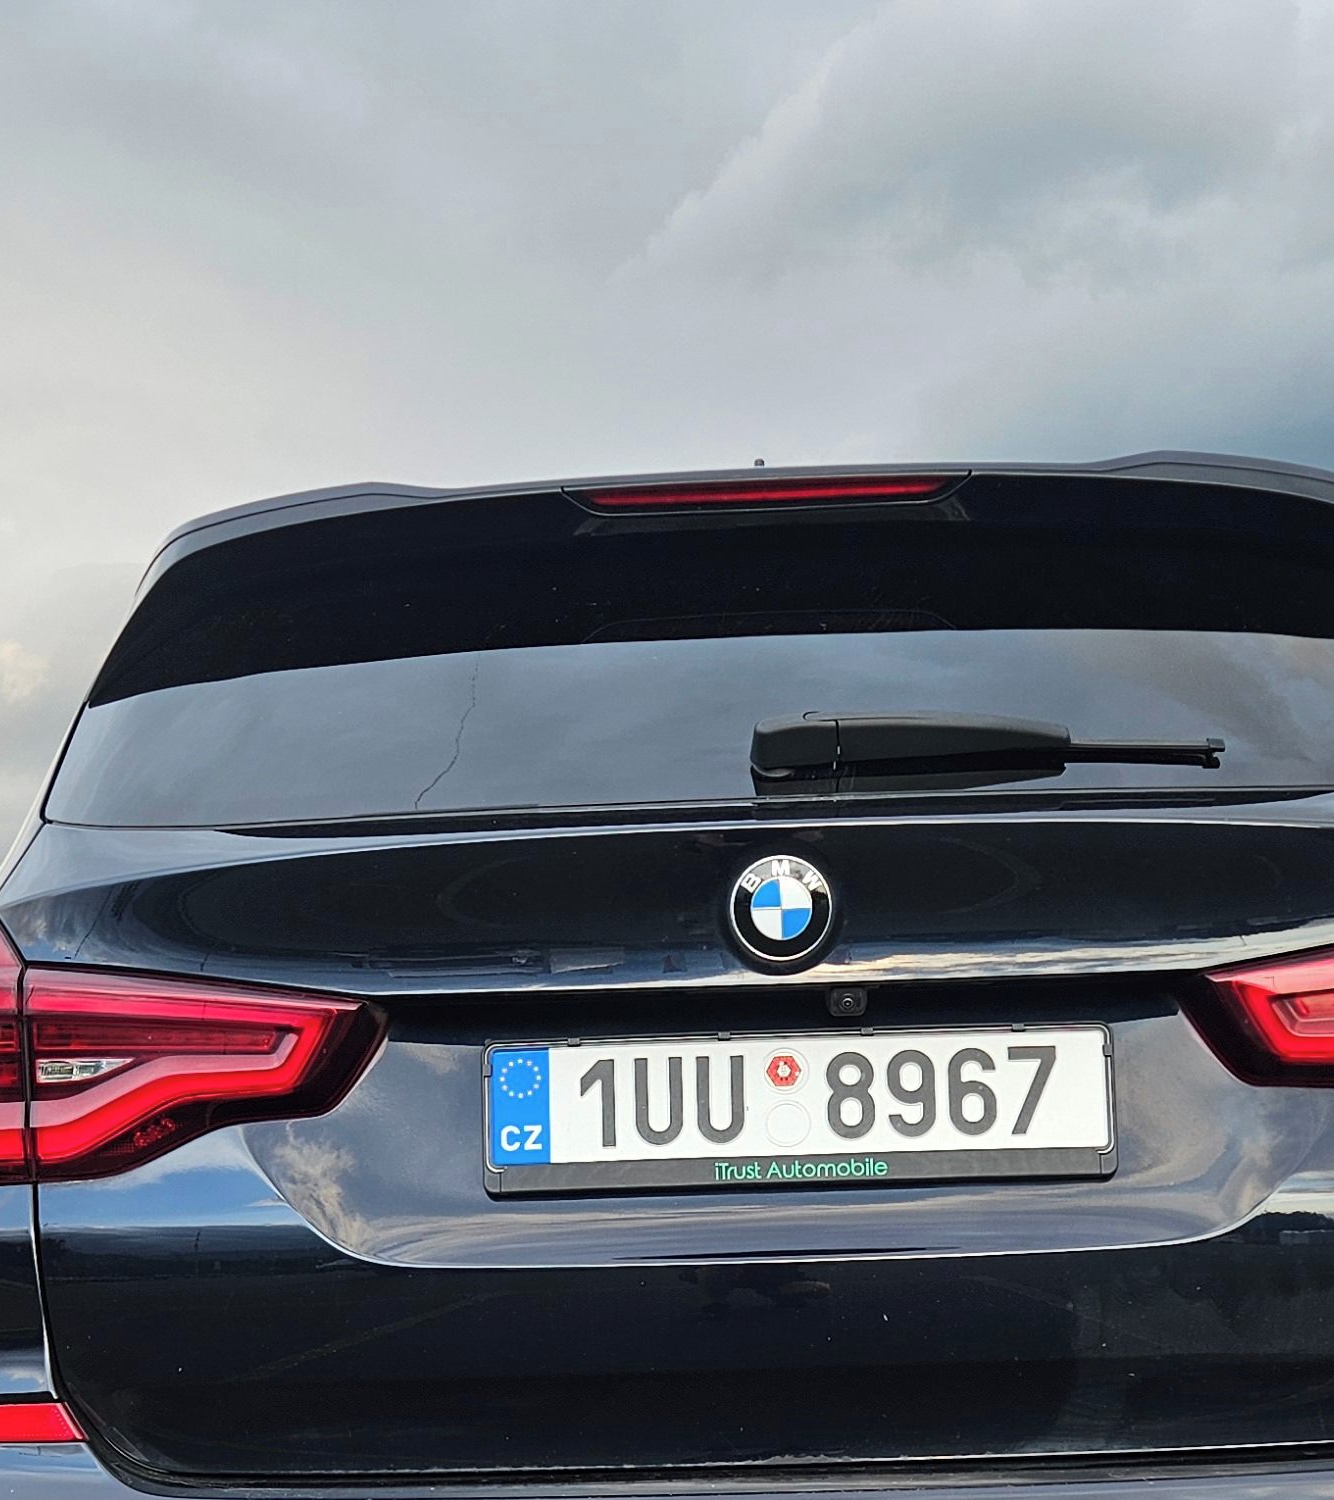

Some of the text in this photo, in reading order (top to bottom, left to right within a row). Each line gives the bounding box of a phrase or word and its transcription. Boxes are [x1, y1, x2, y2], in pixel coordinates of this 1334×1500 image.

[740, 859, 822, 894] BMW
[579, 1045, 1057, 1148] 1UU 8967
[500, 1124, 543, 1151] CZ
[714, 1157, 889, 1181] iTrust Automobile
